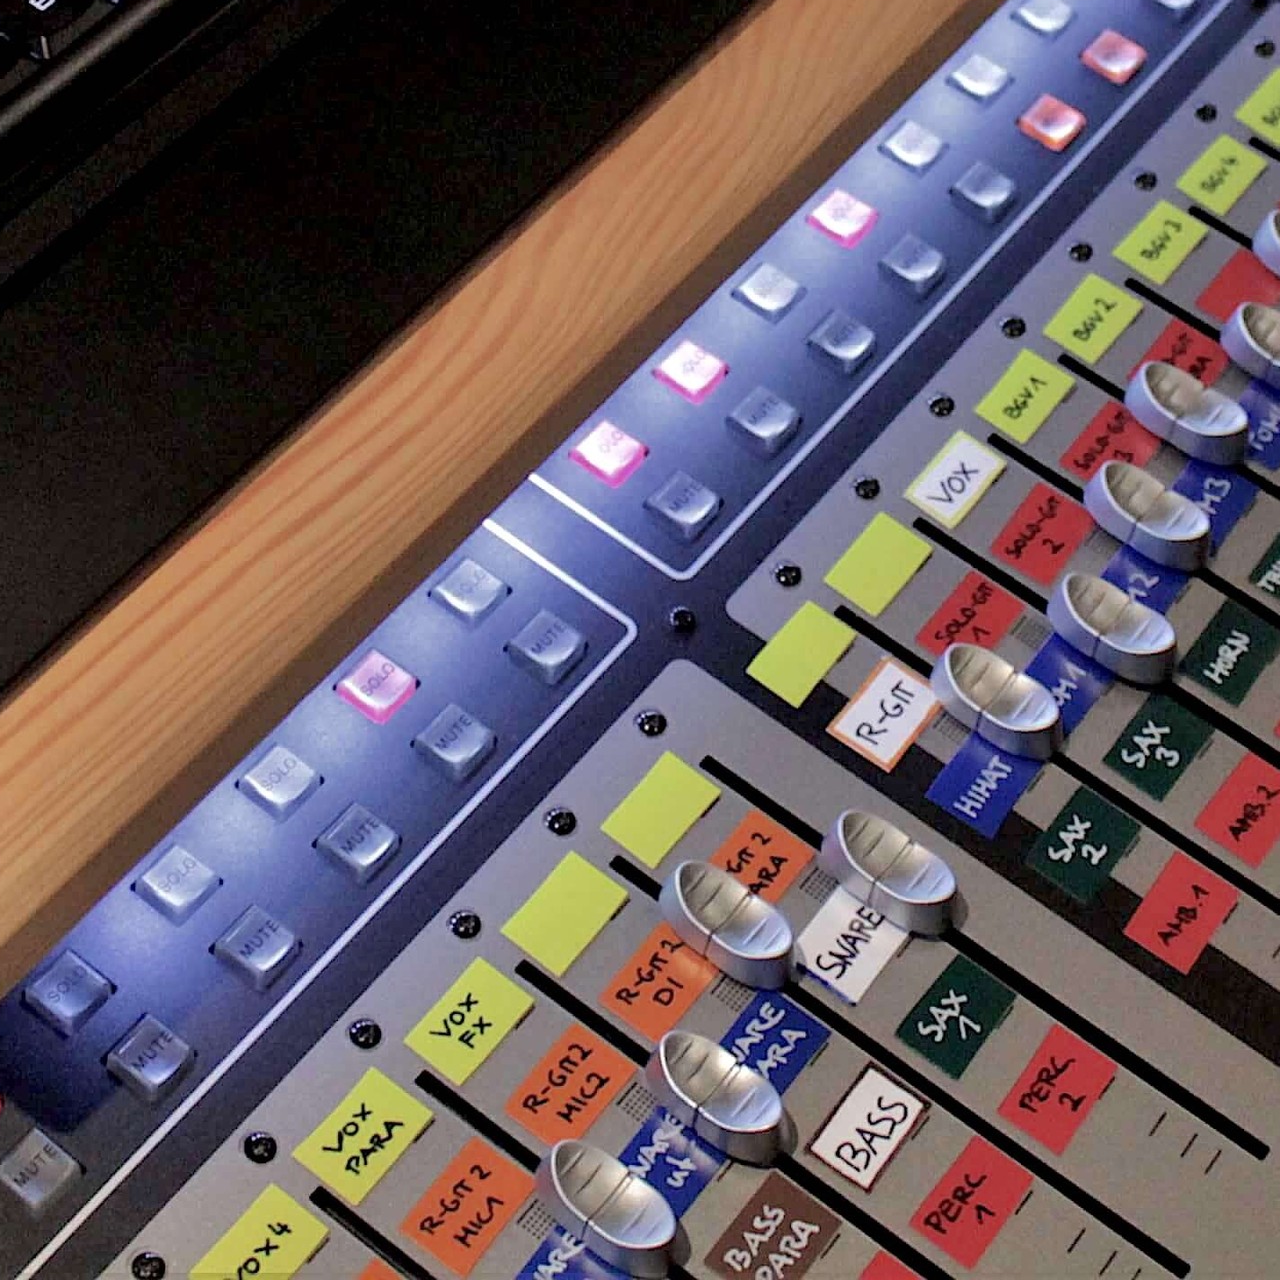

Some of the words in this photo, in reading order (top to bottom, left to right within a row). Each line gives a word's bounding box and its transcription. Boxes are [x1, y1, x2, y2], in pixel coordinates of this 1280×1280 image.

[669, 481, 703, 514] MUTE
[927, 461, 981, 506] VOX
[1044, 537, 1066, 557] 2
[531, 624, 564, 656] MUTE
[1203, 630, 1254, 684] HORN
[360, 662, 396, 699] SOLO
[434, 713, 472, 750] MUTE
[856, 678, 917, 746] R-GIT
[1121, 719, 1172, 769] SAX
[1154, 745, 1181, 768] 3
[262, 756, 299, 793] SOLO
[953, 754, 1014, 820] HIHAT
[340, 816, 382, 855] MUTE
[1047, 813, 1093, 864] SAX
[1079, 841, 1108, 866] 2
[158, 856, 198, 894] SOLO
[750, 854, 788, 896] ARA
[239, 920, 279, 959] MUTE
[816, 906, 885, 980] SNARE
[48, 964, 89, 1004] SOLO
[430, 993, 479, 1038] VOX
[459, 1017, 492, 1050] FX
[918, 989, 969, 1043] SAX
[958, 1015, 983, 1042] 1
[132, 1030, 174, 1072] MUTE
[755, 1029, 808, 1080] ARA
[556, 1072, 611, 1124] MIC2
[1018, 1056, 1078, 1113] PERC
[1058, 1092, 1088, 1114] 2
[322, 1103, 373, 1156] VOX
[345, 1121, 404, 1175] PARA
[836, 1096, 908, 1172] BASS
[14, 1144, 55, 1187] MUTE
[469, 1164, 493, 1182] 2
[923, 1172, 988, 1235] PERC
[976, 1204, 997, 1222] 1
[267, 1221, 292, 1238] 4
[723, 1203, 786, 1273] BASS
[753, 1219, 821, 1280] PARA
